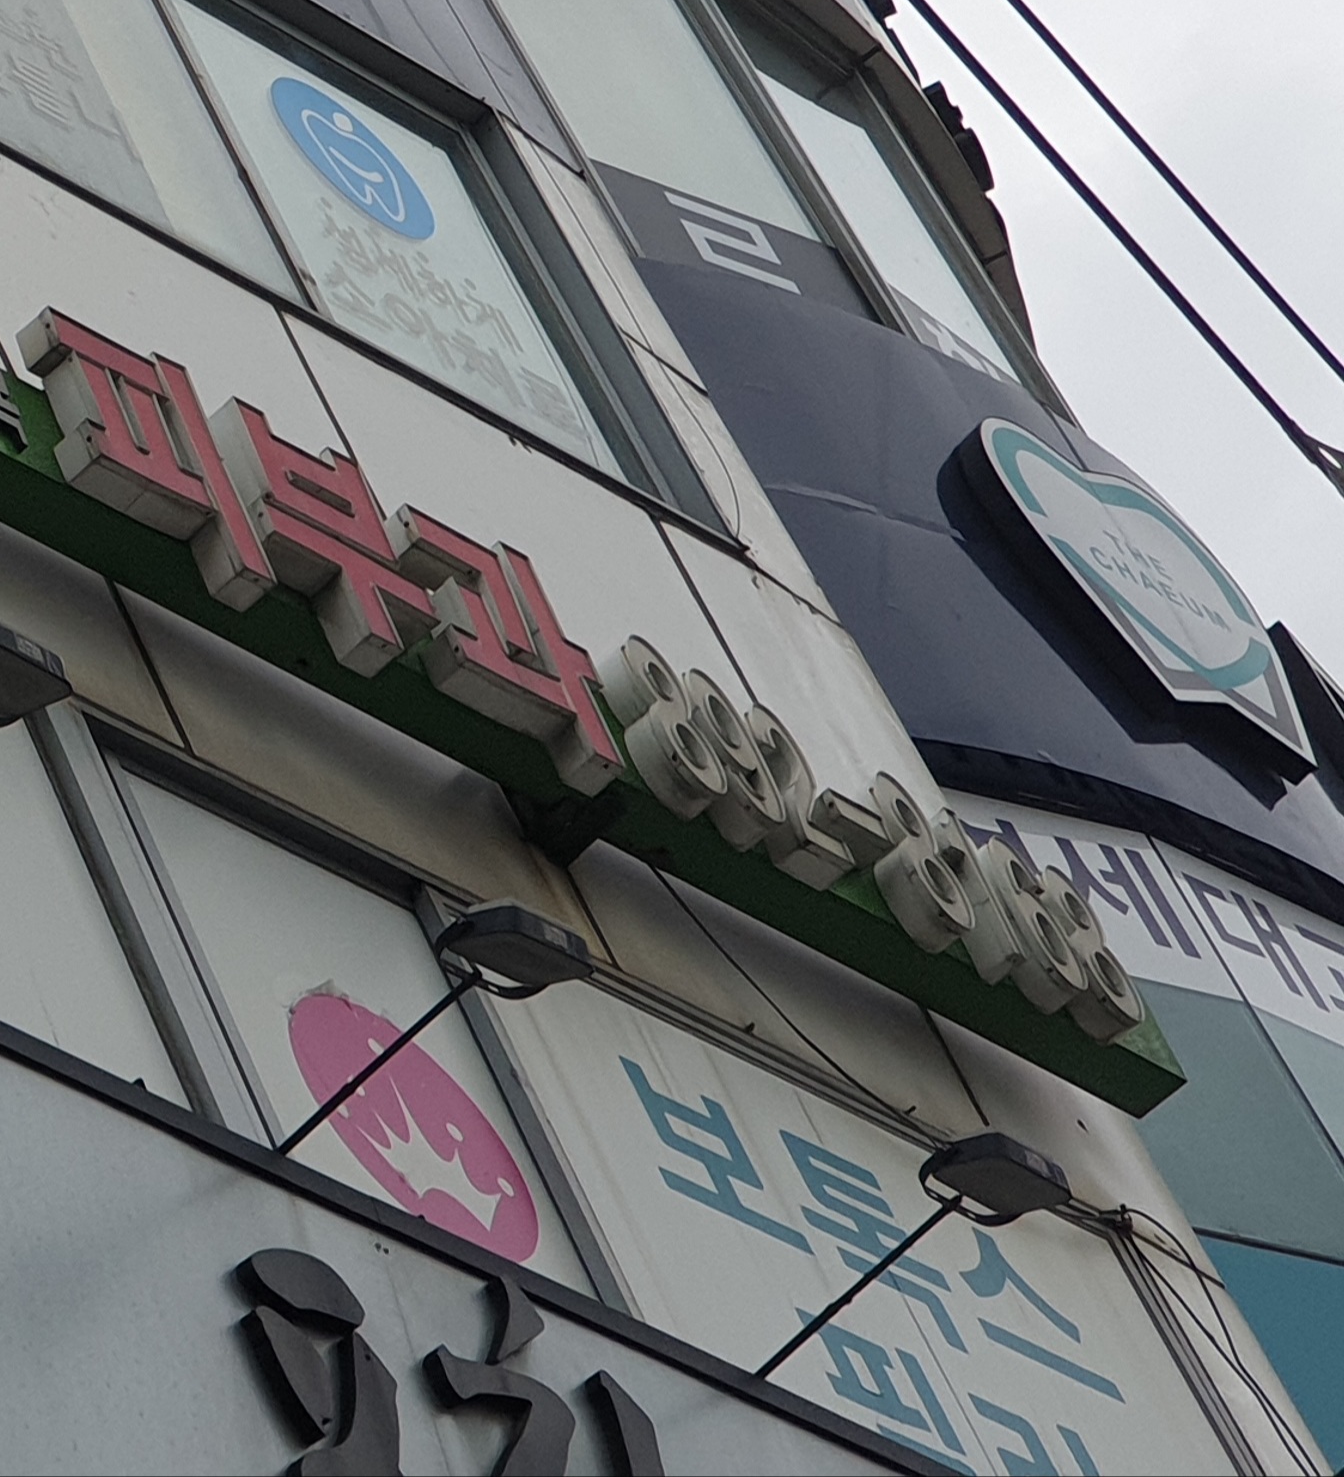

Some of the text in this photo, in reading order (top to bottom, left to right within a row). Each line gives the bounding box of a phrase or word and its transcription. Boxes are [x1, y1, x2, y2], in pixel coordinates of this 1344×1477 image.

[1089, 546, 1232, 634] CHAEUM
[1102, 528, 1174, 582] THE
[24, 306, 1146, 1030] 피부과 892-8168
[619, 1054, 1126, 1404] 보톡스
